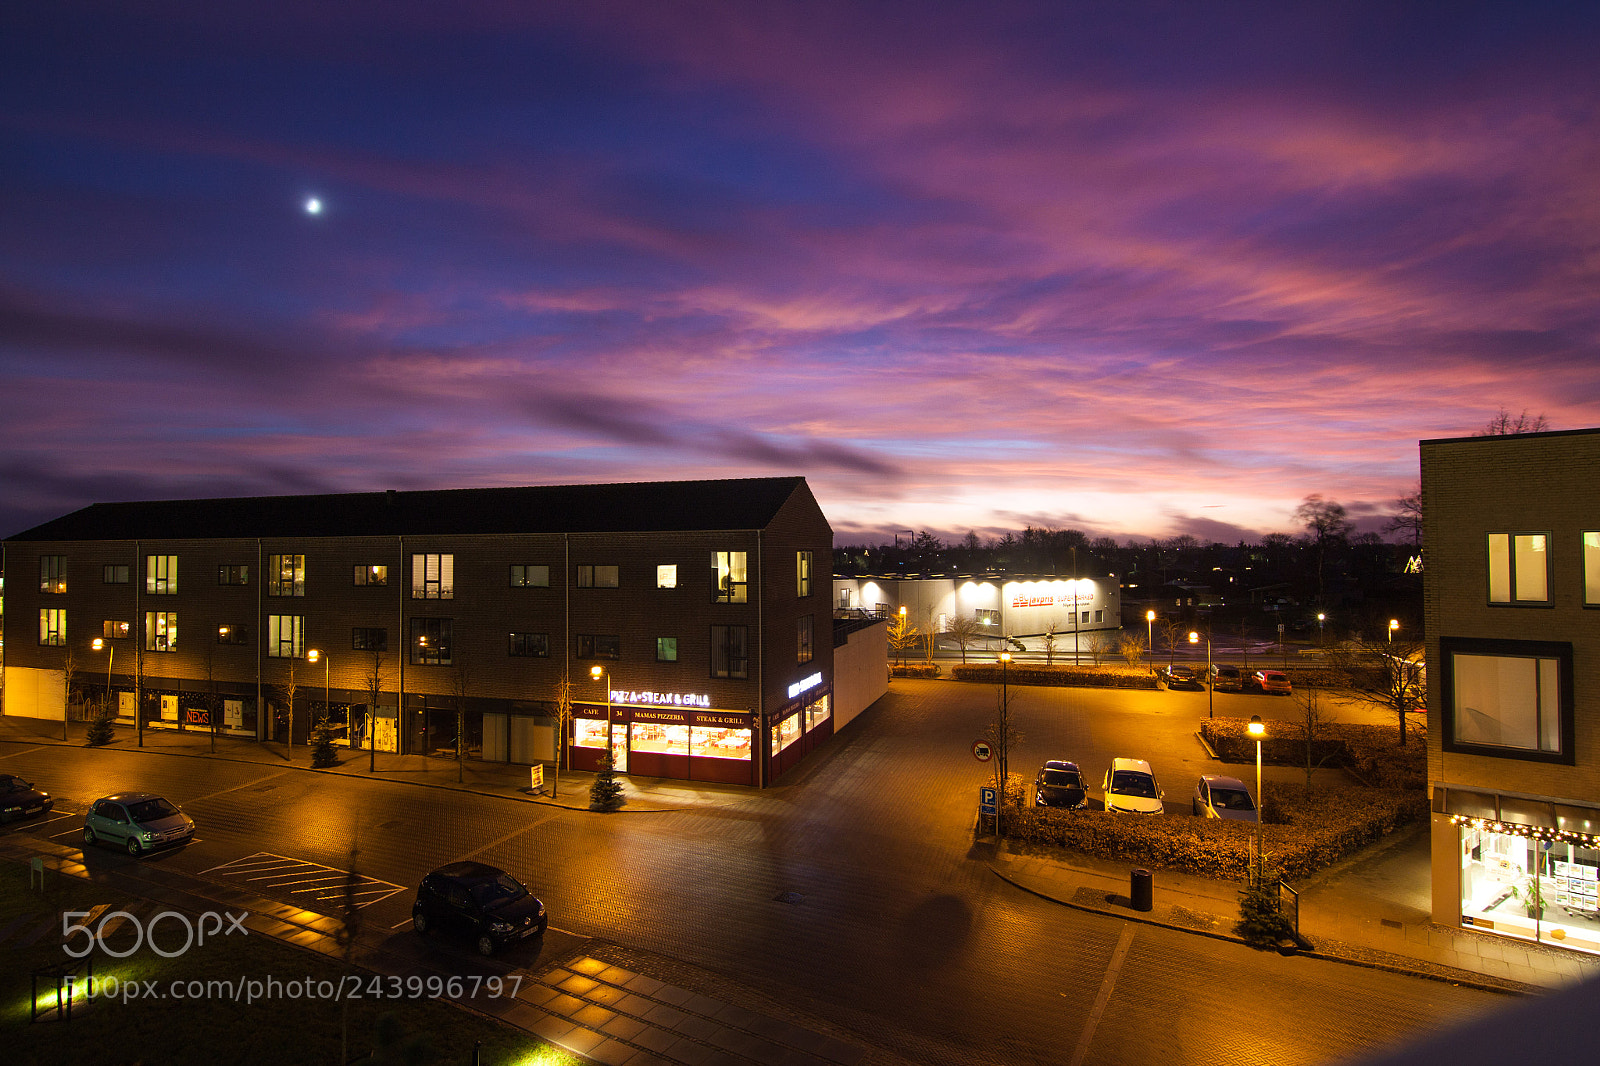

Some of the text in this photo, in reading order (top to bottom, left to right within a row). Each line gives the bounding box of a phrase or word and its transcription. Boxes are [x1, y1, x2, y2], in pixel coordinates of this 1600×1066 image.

[186, 711, 209, 723] NEWS
[634, 712, 685, 721] MAMAS PIZZERIA
[696, 715, 717, 723] STEAK
[724, 717, 745, 725] GRILL
[985, 791, 993, 803] P
